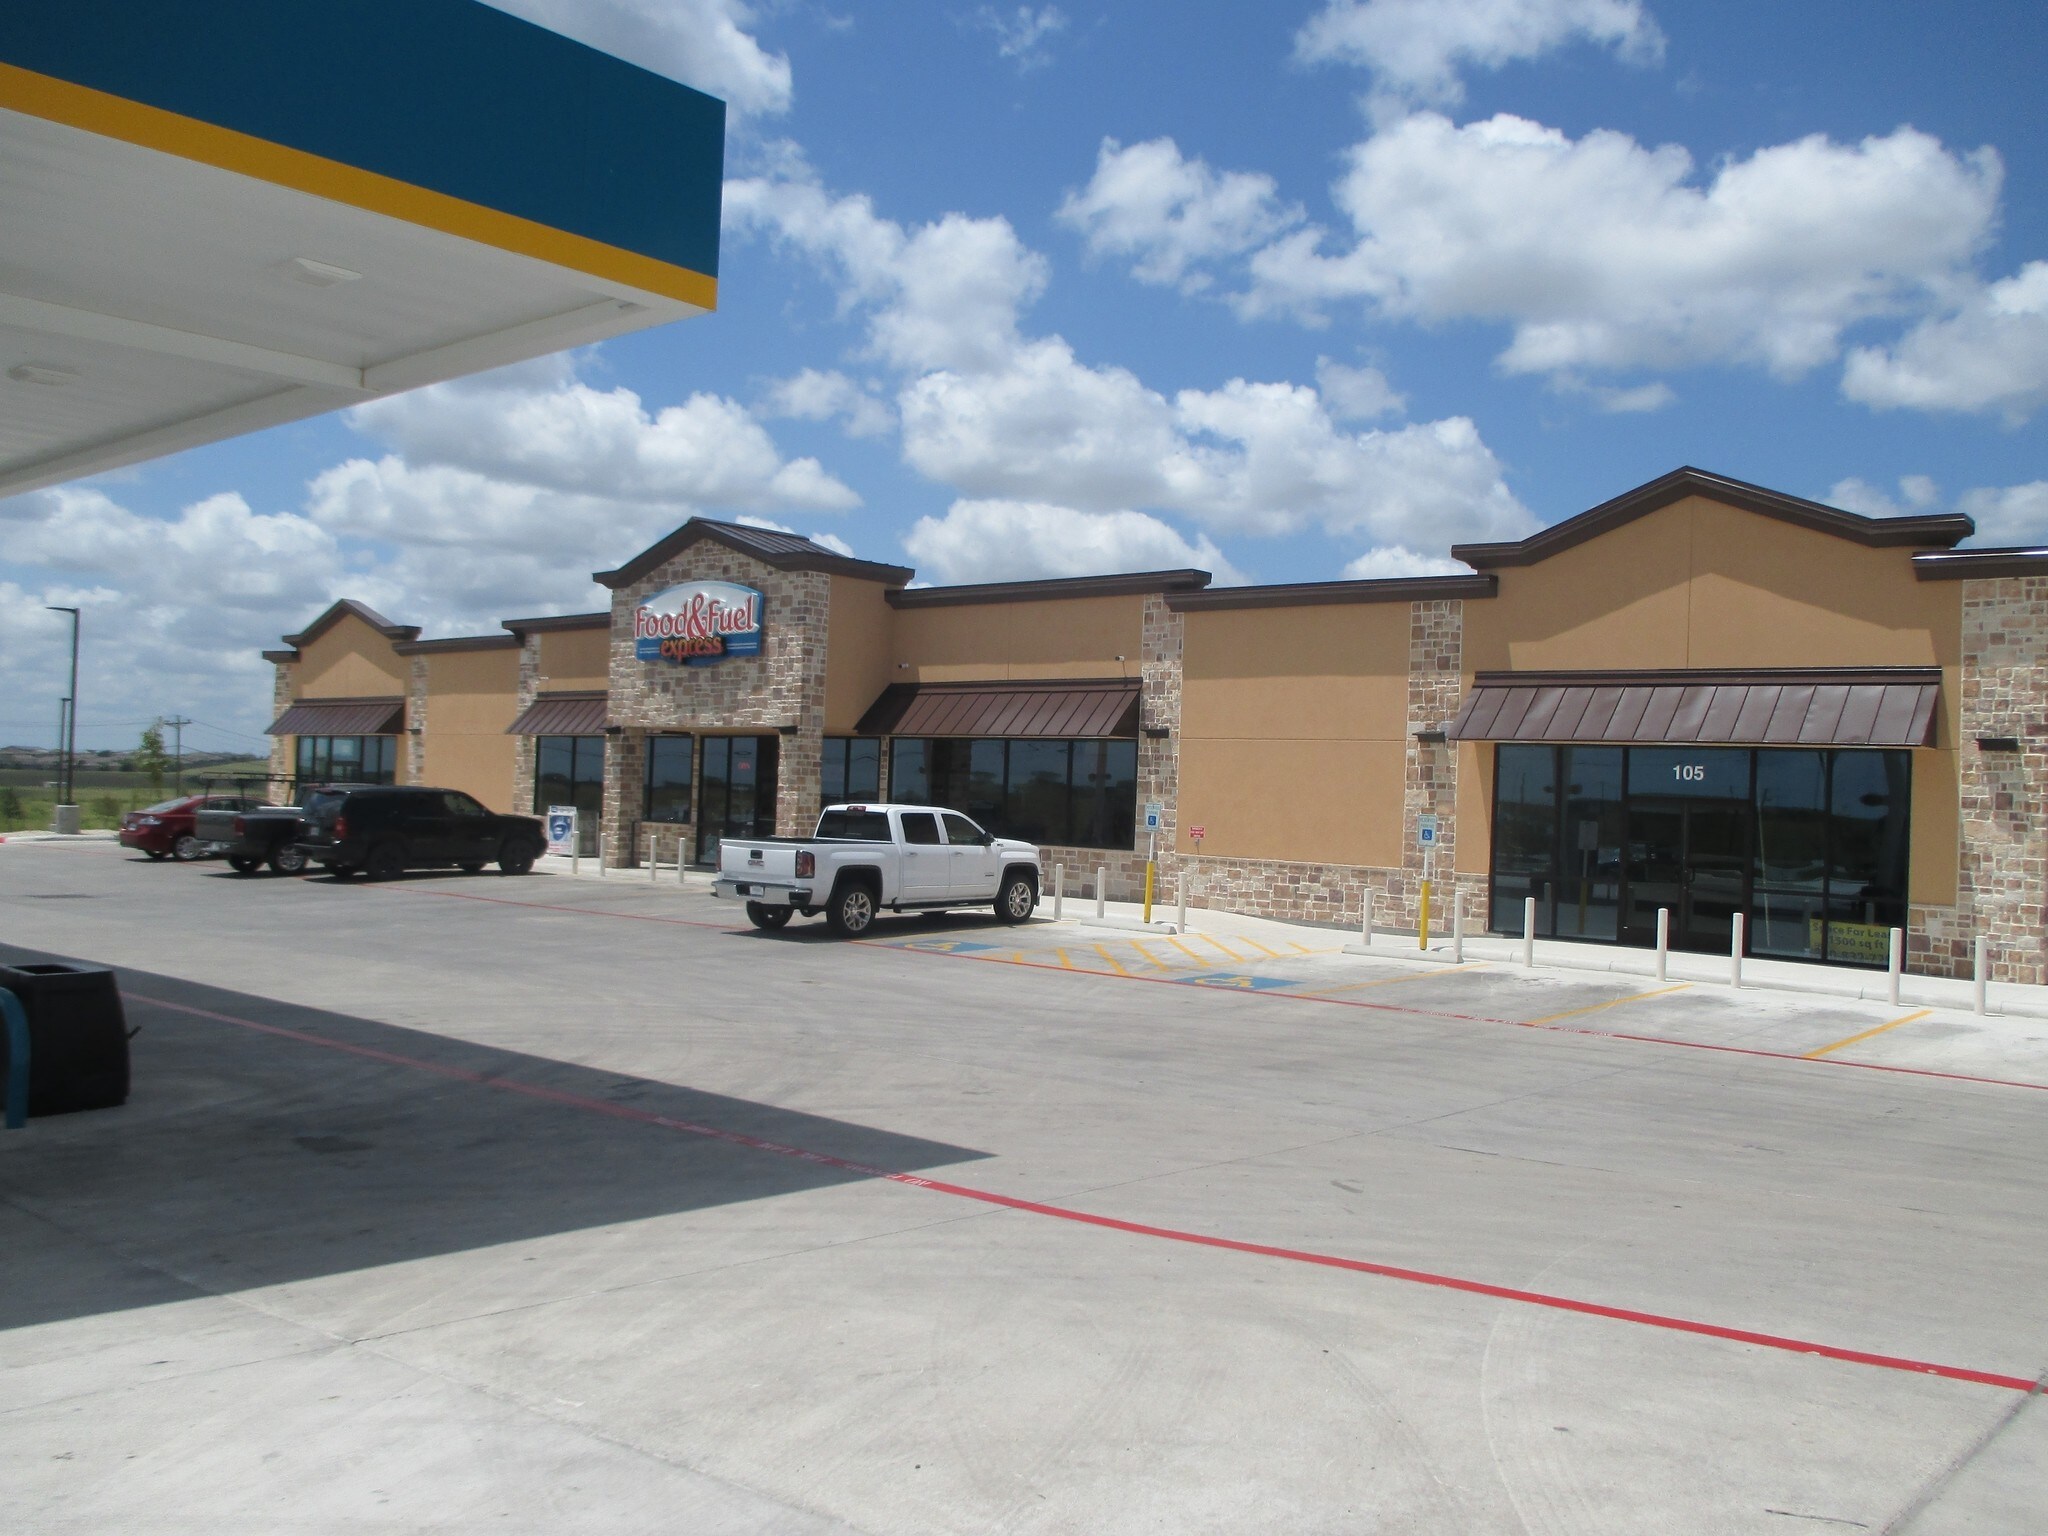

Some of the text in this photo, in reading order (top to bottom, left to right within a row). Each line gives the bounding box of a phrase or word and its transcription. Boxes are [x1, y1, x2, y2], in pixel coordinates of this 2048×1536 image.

[660, 637, 724, 664] express
[1672, 765, 1704, 781] 105
[1859, 941, 1873, 950] sq
[1875, 940, 1885, 949] ft
